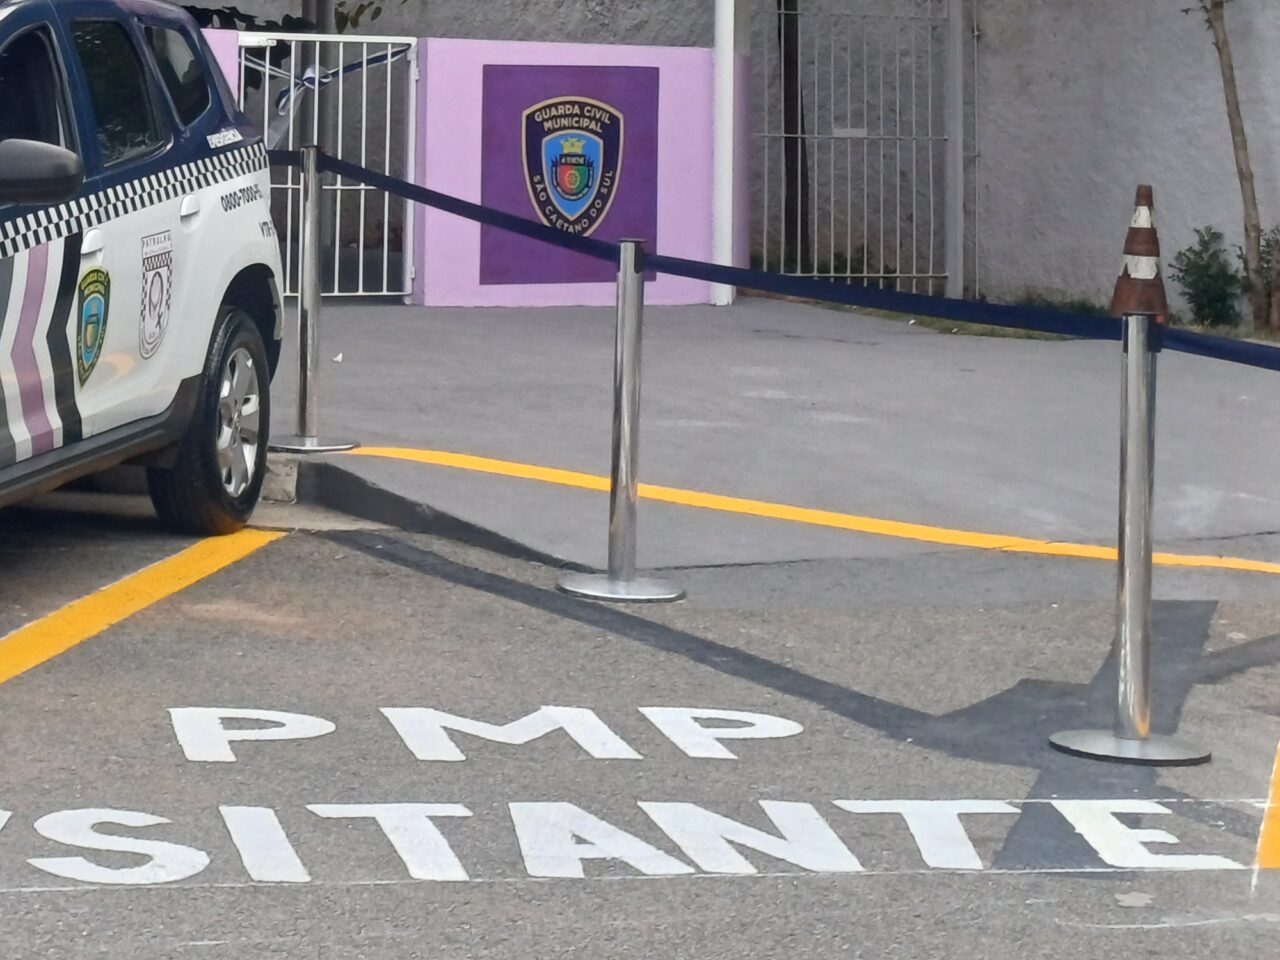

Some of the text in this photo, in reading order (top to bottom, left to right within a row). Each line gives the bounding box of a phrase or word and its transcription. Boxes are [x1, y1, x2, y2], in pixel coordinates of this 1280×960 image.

[534, 104, 611, 124] GUARDA CIVIL
[543, 117, 603, 132] MUNICIPAL
[533, 170, 613, 233] SÃO CAETANO DO SUL
[168, 706, 804, 762] PMP
